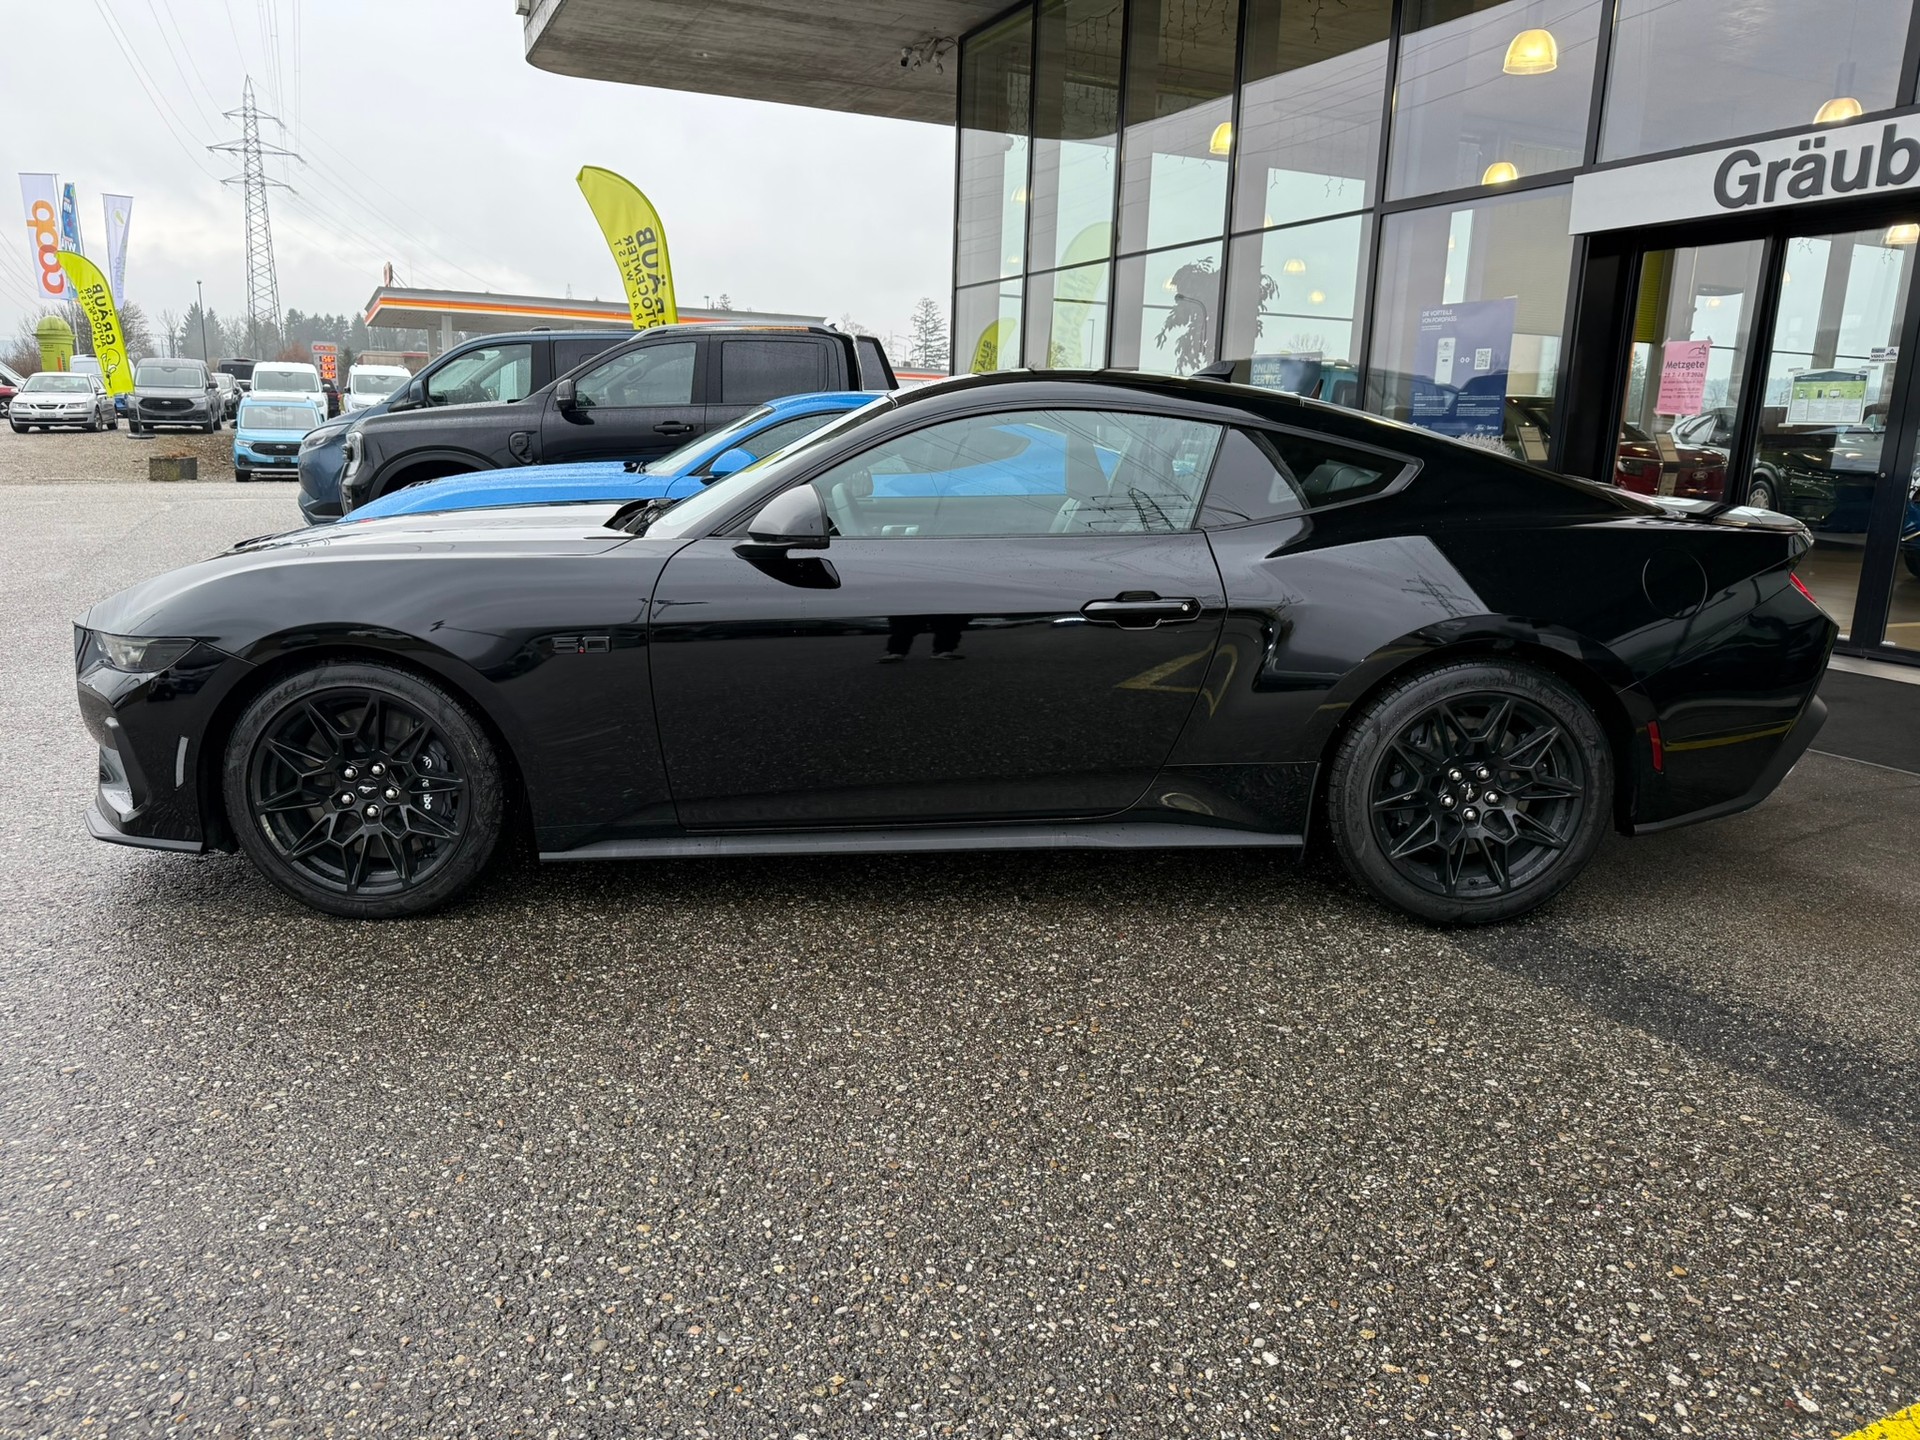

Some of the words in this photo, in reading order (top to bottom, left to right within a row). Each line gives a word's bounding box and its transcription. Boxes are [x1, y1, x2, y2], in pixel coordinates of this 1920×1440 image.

[1714, 123, 1920, 209] Gräub
[1254, 363, 1280, 374] ONLINE
[1665, 361, 1705, 370] Metzgete
[1253, 374, 1282, 385] SERVICE
[552, 636, 610, 654] 5.0
